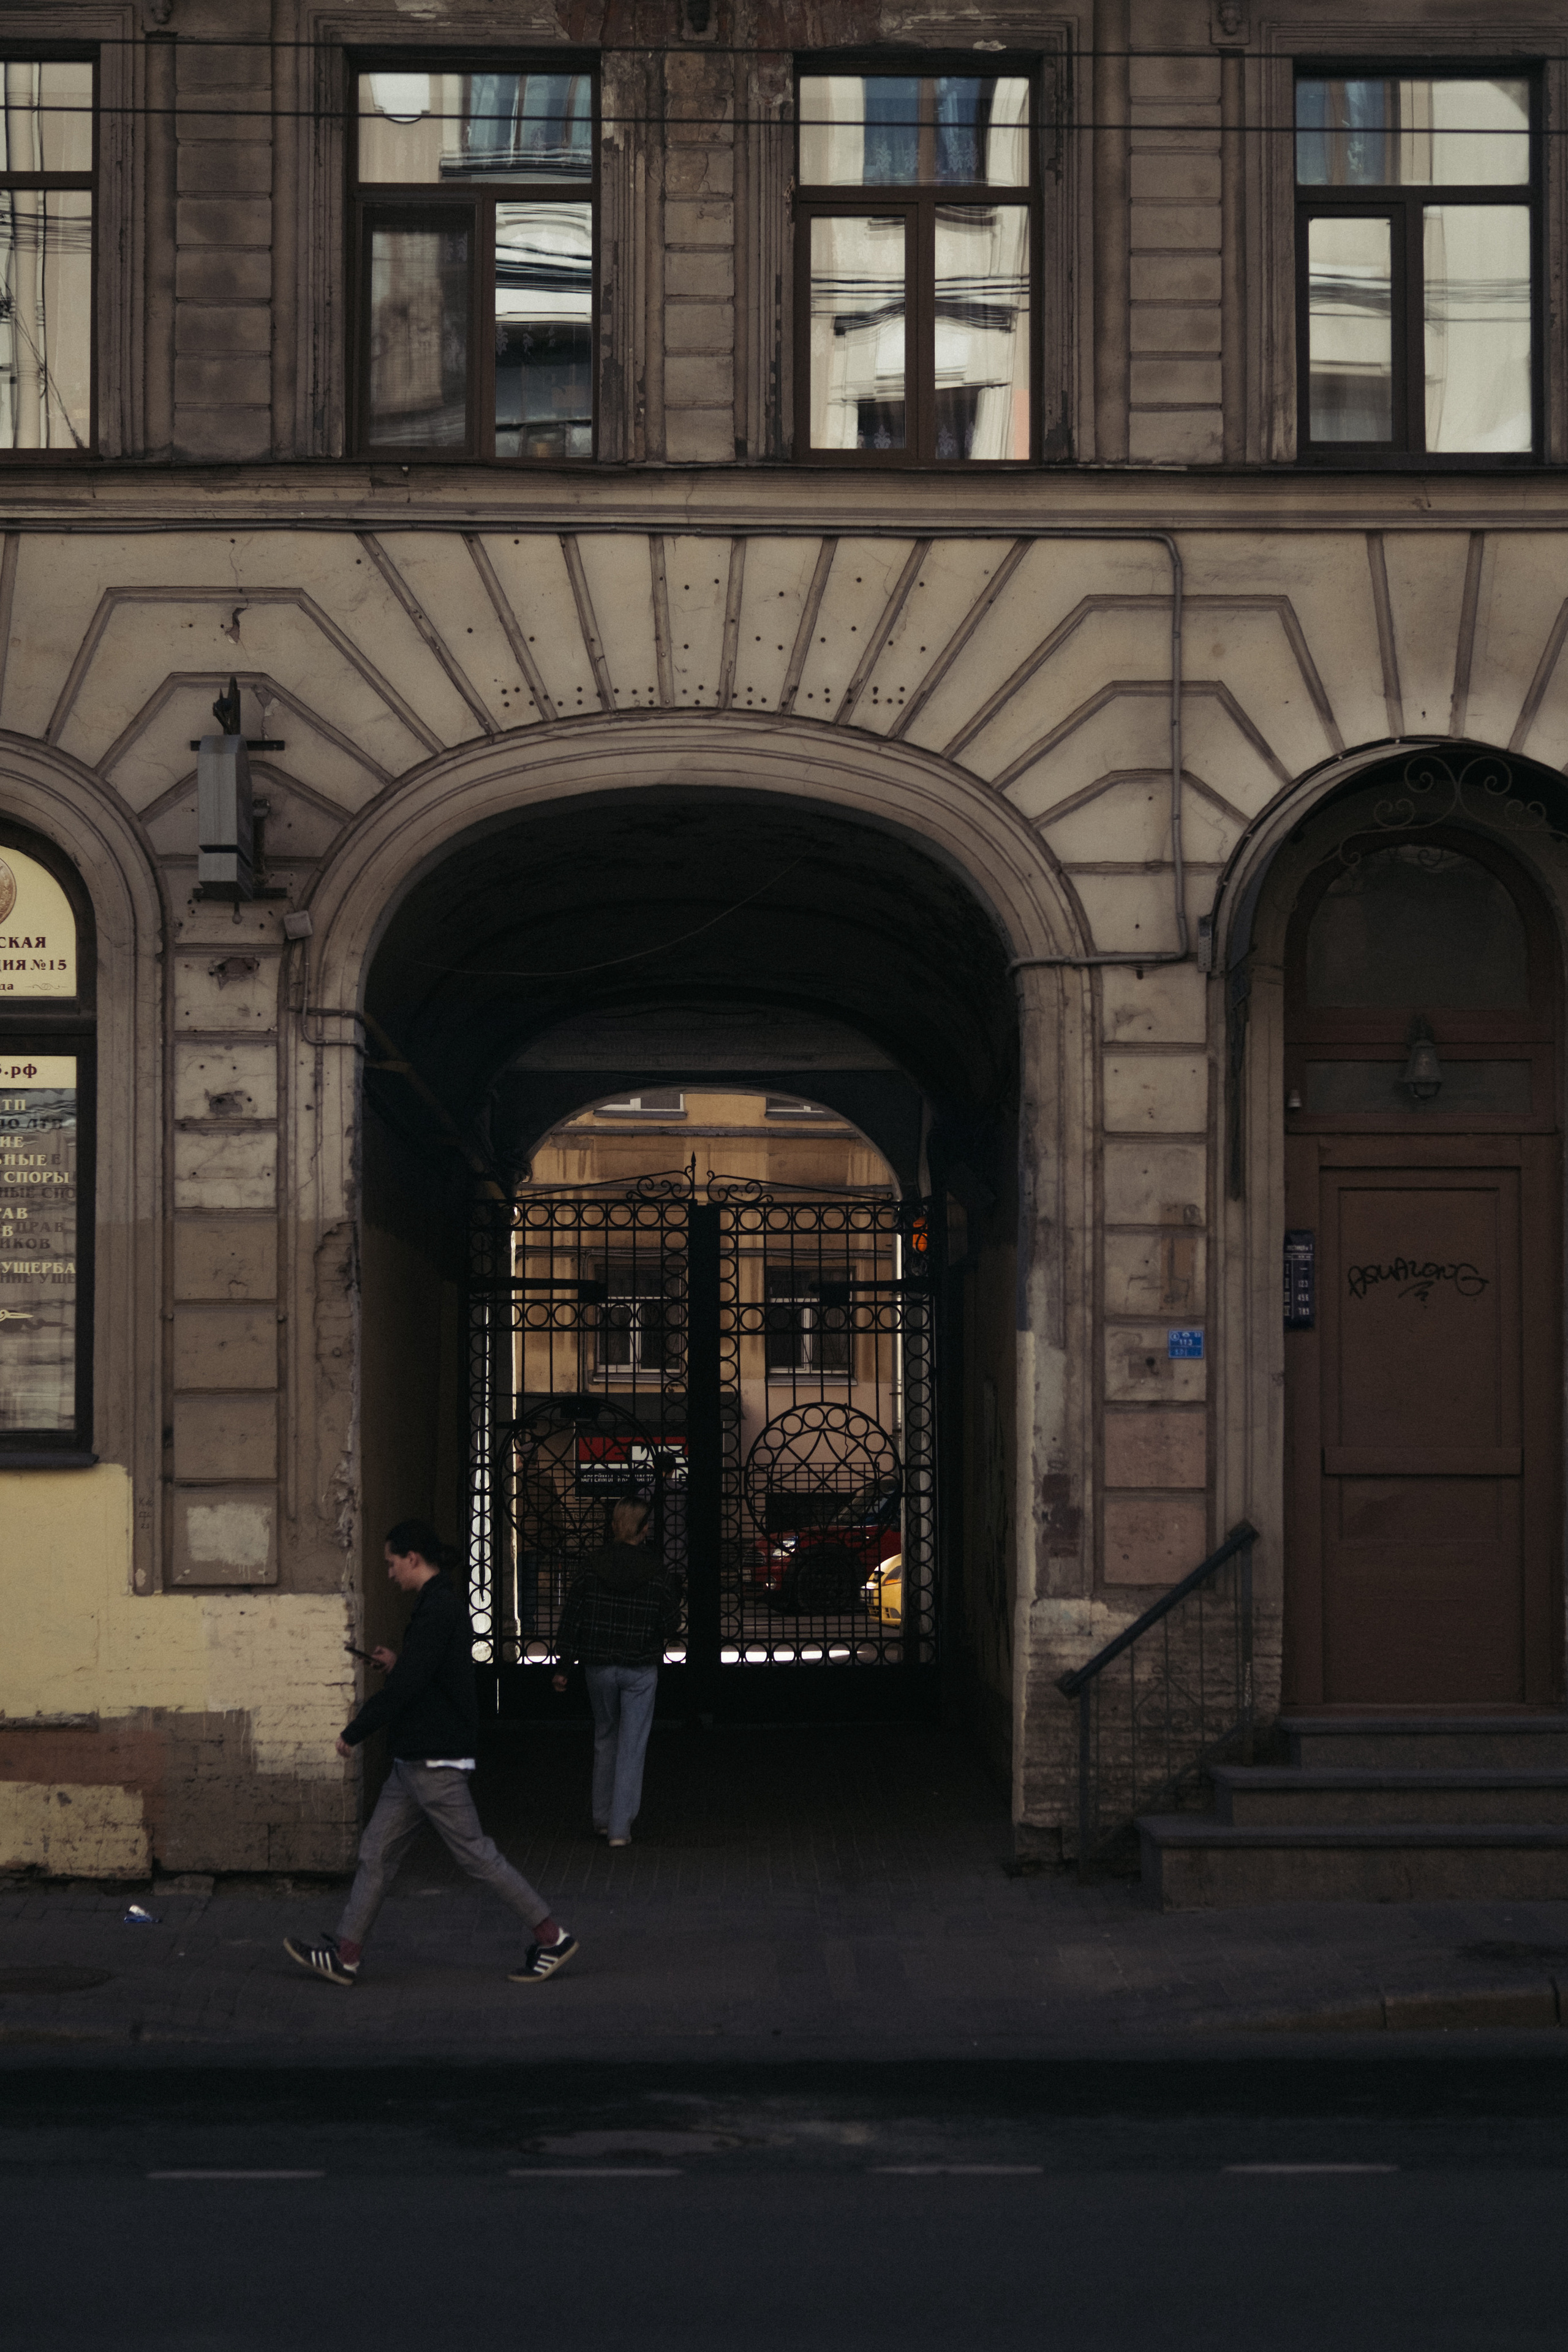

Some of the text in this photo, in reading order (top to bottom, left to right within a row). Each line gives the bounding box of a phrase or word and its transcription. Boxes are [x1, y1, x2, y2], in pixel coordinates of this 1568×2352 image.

[30, 959, 67, 970] №15
[0, 1063, 37, 1078] .рф
[0, 1099, 26, 1111] ТП
[0, 1154, 47, 1166] НЫЕ
[4, 1171, 69, 1183] СПОРЫ
[0, 1208, 28, 1219] АВ
[1, 1262, 76, 1275] УЩЕРБА
